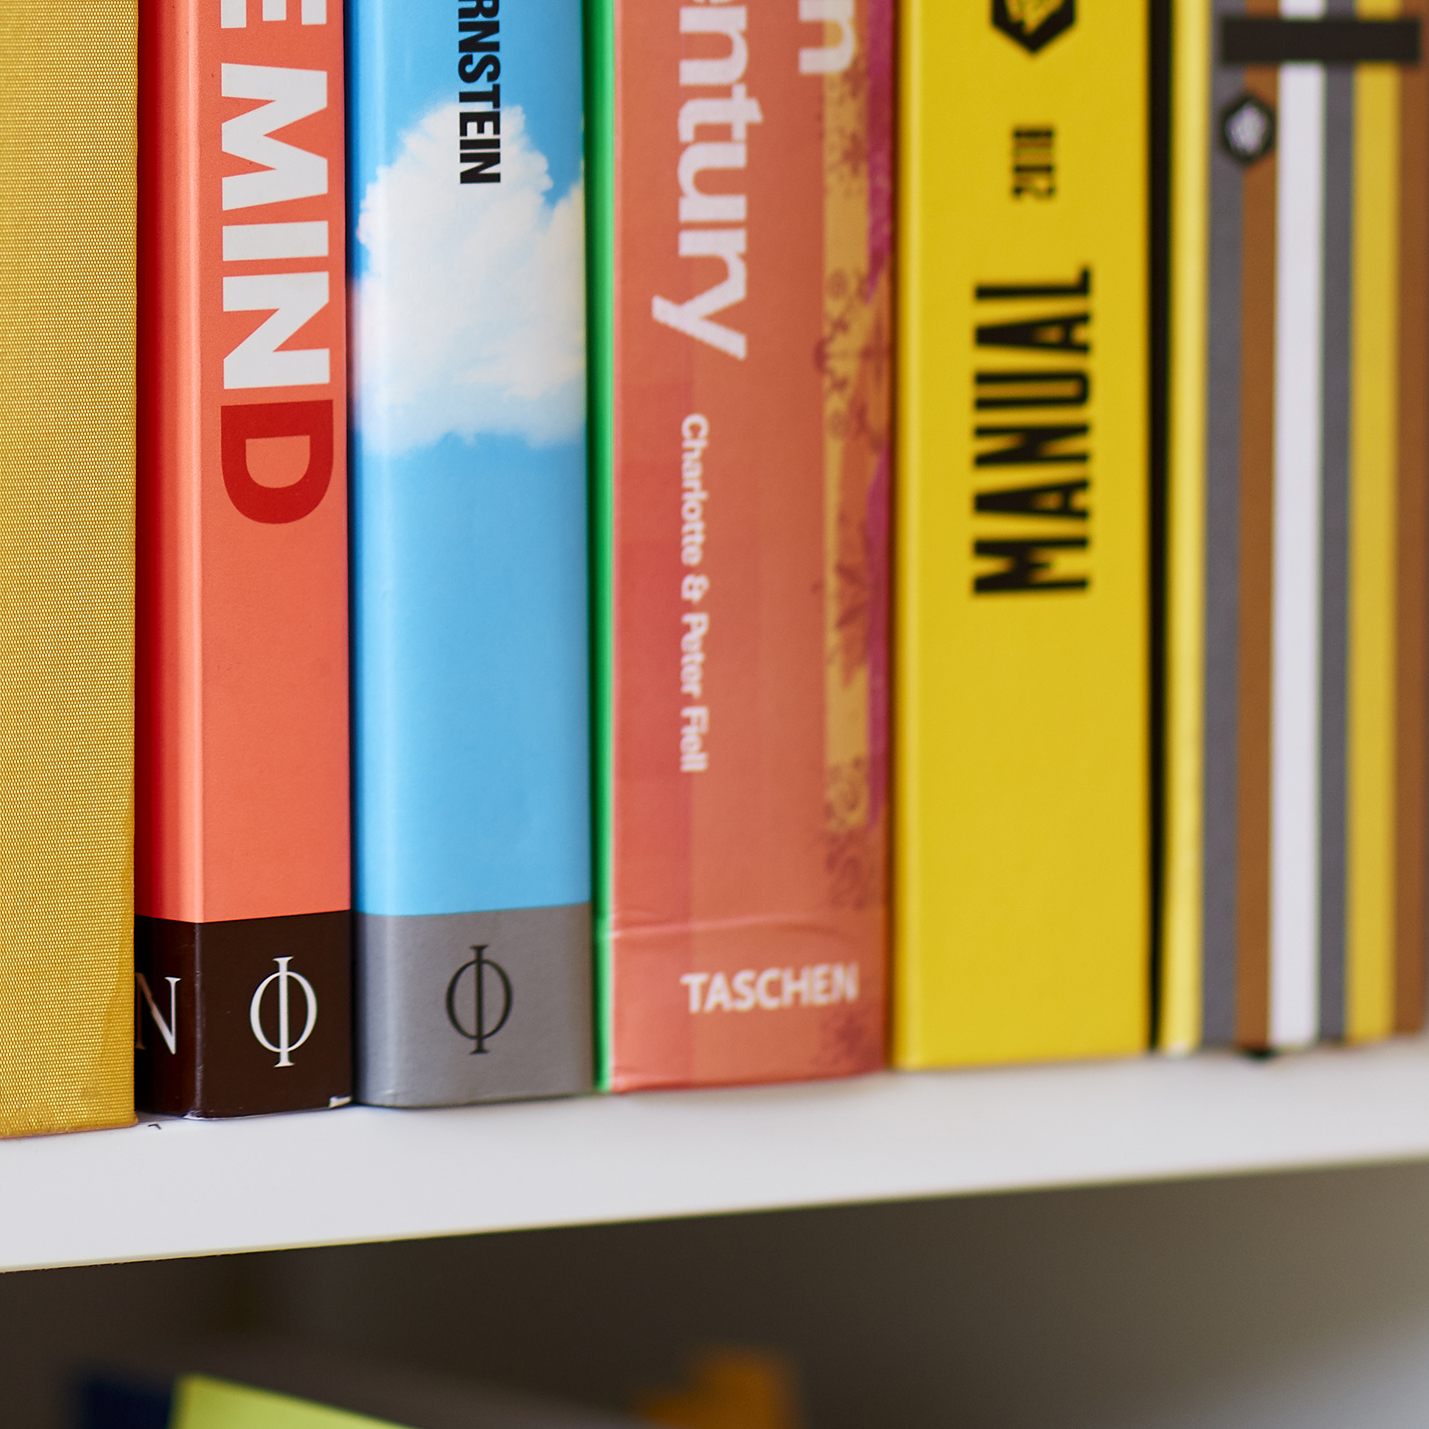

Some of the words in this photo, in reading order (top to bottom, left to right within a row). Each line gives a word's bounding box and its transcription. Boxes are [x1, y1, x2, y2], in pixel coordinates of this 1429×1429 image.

[221, 75, 335, 525] MIND
[974, 270, 1090, 595] MANUAL
[681, 413, 709, 566] Charlotte
[680, 574, 709, 603] &
[680, 612, 709, 699] Peter
[679, 705, 709, 772] Fiell
[679, 962, 858, 1014] TASCHEN
